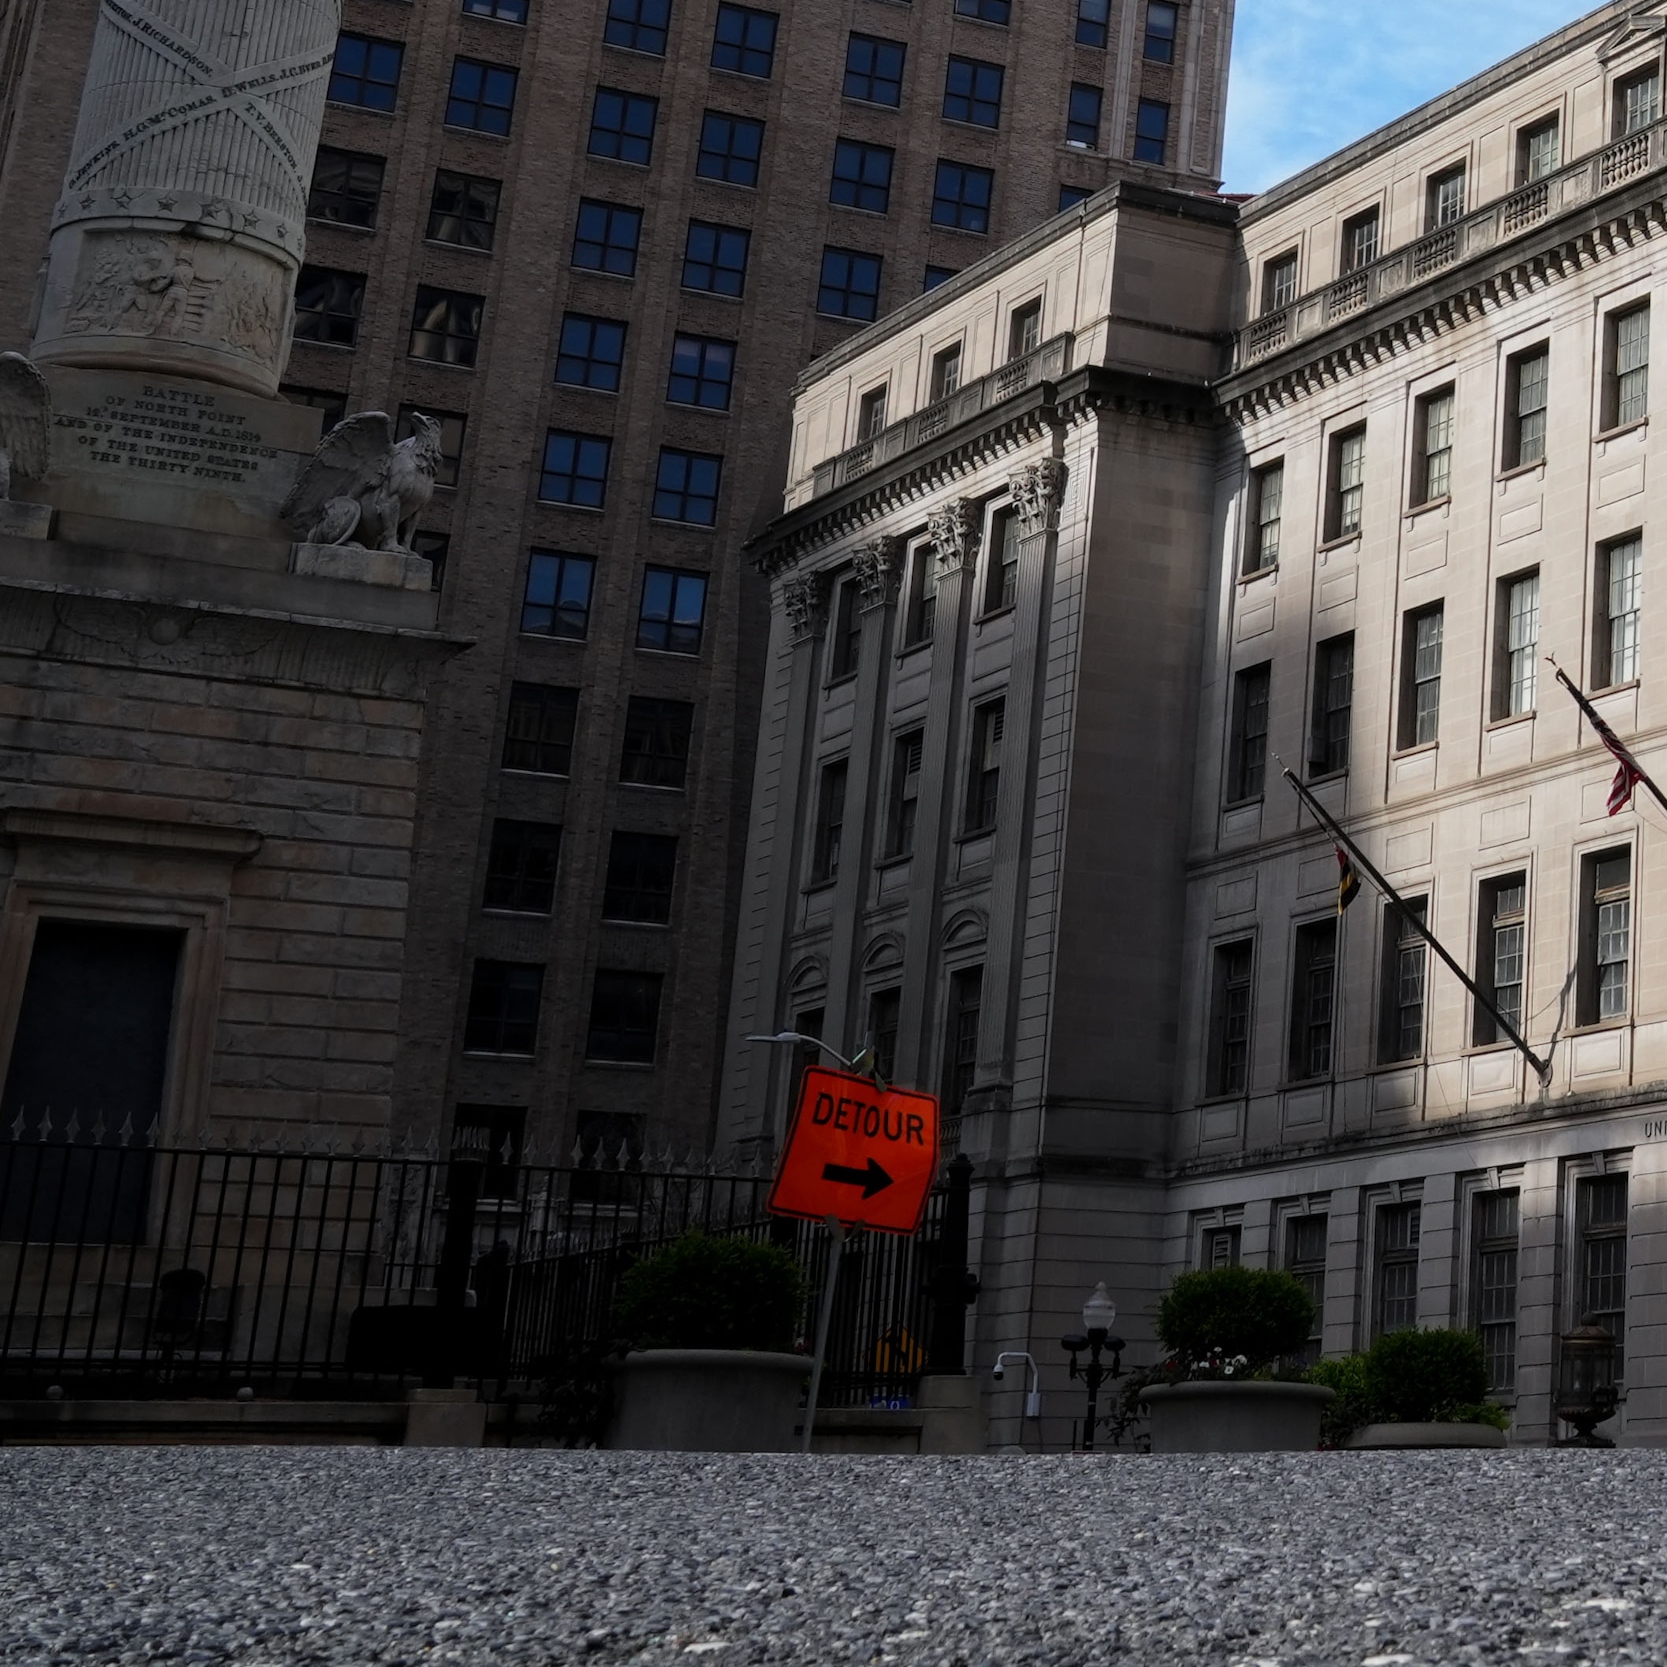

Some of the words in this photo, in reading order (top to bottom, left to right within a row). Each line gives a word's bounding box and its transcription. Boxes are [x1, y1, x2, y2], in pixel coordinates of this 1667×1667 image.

[105, 395, 125, 407] OF
[134, 400, 188, 417] NORTH
[199, 409, 246, 426] POINT
[142, 385, 216, 407] BATTLE
[110, 410, 200, 433] SEPTEMBER
[78, 435, 98, 447] OF
[107, 439, 138, 453] THE
[145, 444, 200, 462] UNITED
[206, 454, 259, 471] STATES
[94, 423, 112, 433] OF
[122, 426, 153, 440] THE
[159, 432, 278, 459] INDEPENDENCE
[90, 450, 121, 464] THE
[811, 1092, 925, 1146] DETOUR
